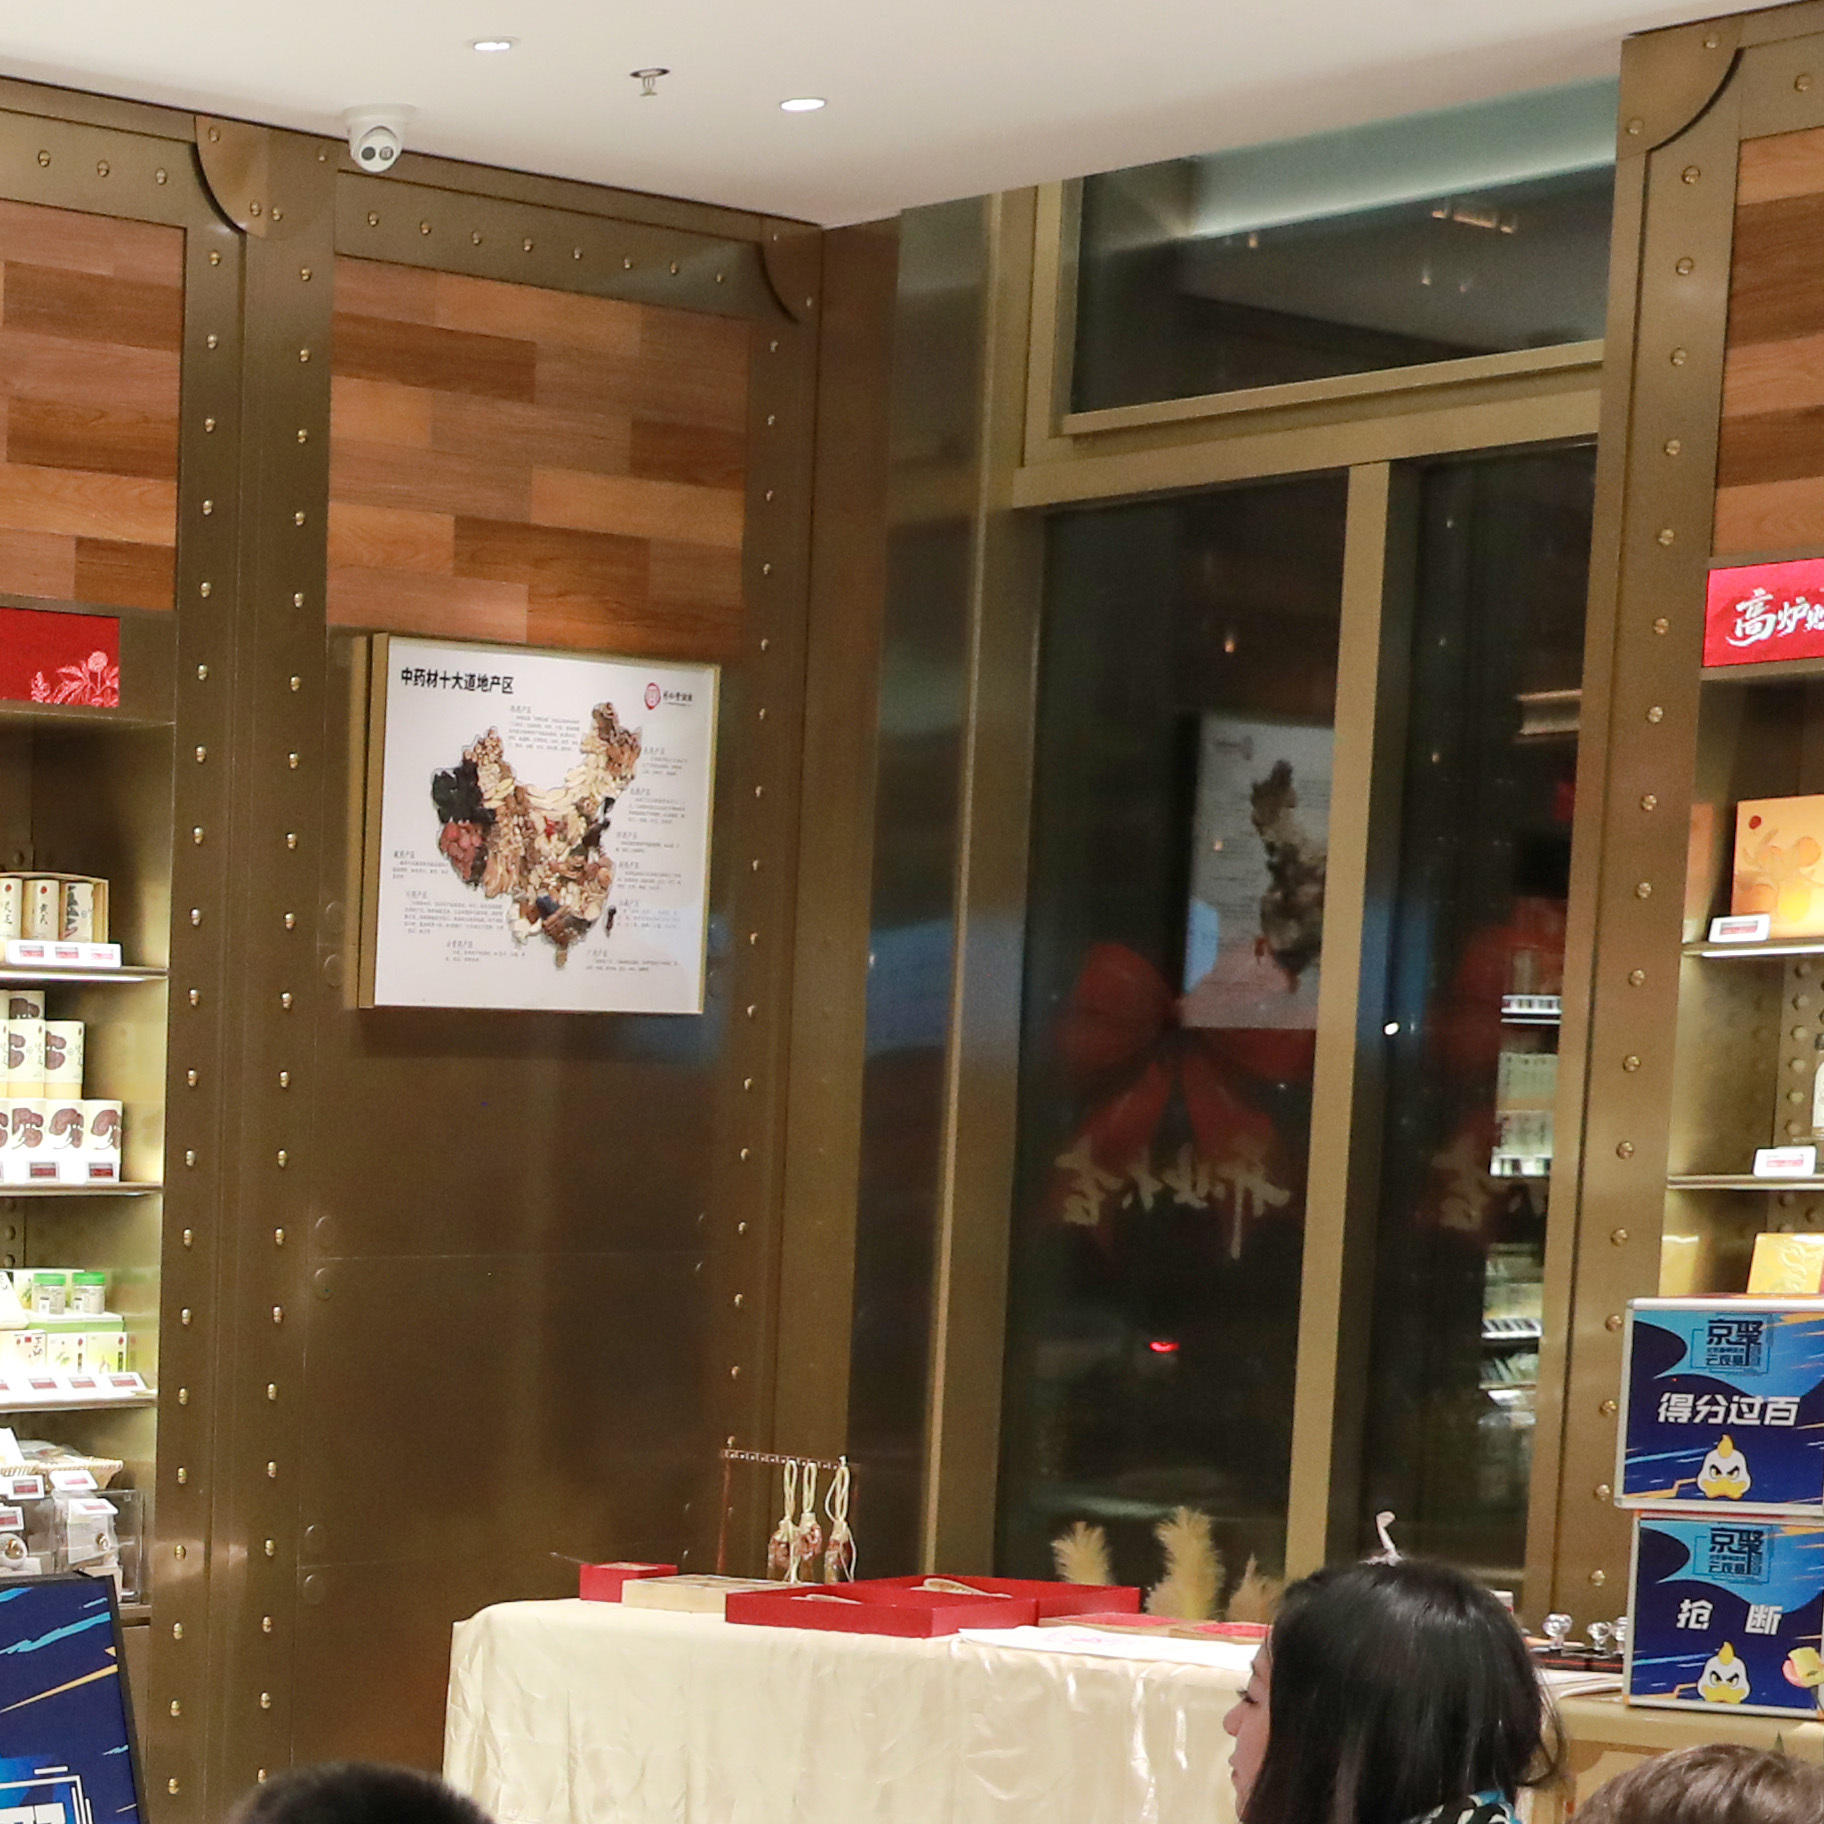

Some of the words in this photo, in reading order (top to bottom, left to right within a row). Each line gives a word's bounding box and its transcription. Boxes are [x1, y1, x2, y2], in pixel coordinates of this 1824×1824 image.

[400, 667, 514, 695] 中药材十大道地产区
[1657, 1392, 1801, 1427] 得分过百
